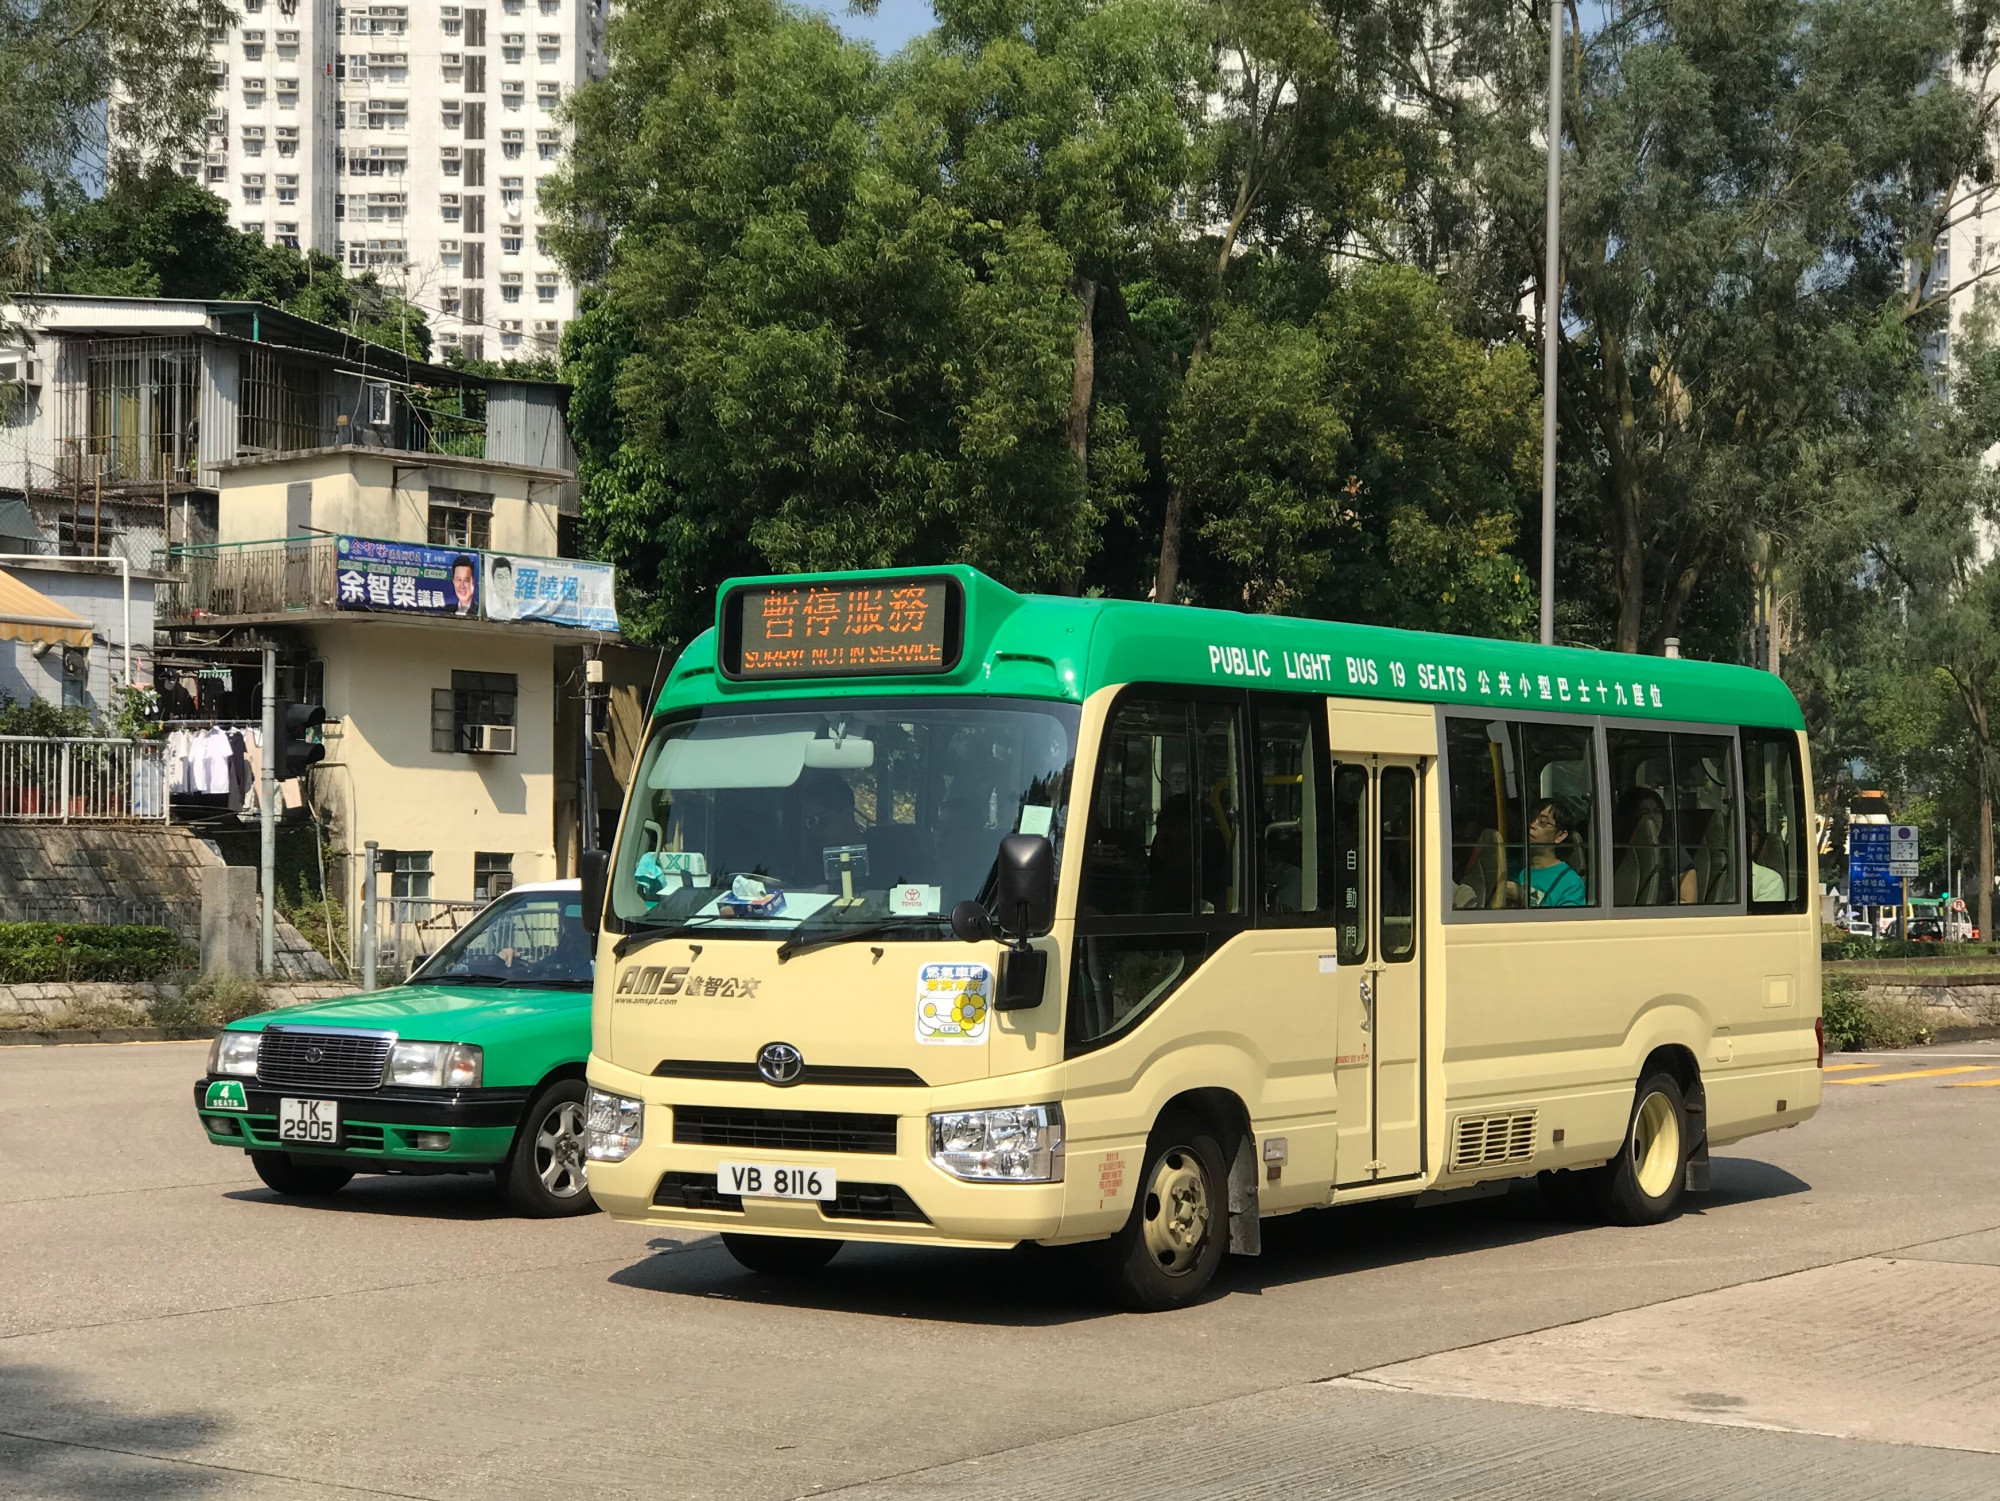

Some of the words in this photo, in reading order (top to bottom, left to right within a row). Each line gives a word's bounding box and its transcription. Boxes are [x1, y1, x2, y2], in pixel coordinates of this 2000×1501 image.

[339, 570, 417, 607] 余智榮
[417, 589, 446, 607] 議員
[514, 568, 578, 603] 羅曉楓
[762, 584, 929, 639] 暫停服務
[1208, 645, 1272, 677] PUBLIC
[1283, 651, 1332, 681] LIGHT
[1346, 656, 1378, 685] BUS
[1389, 661, 1406, 687] 19
[1417, 663, 1468, 692] SEATS
[1478, 669, 1663, 708] 公共小型巴士十九座位
[616, 965, 690, 995] AMS
[685, 975, 761, 998] 進智公交
[614, 997, 678, 1006] www.amspt.com
[213, 1099, 238, 1107] SEATS
[220, 1085, 229, 1098] 4
[297, 1101, 320, 1121] TK
[283, 1120, 333, 1142] 2905
[731, 1166, 762, 1192] VB
[774, 1169, 822, 1195] 8116
